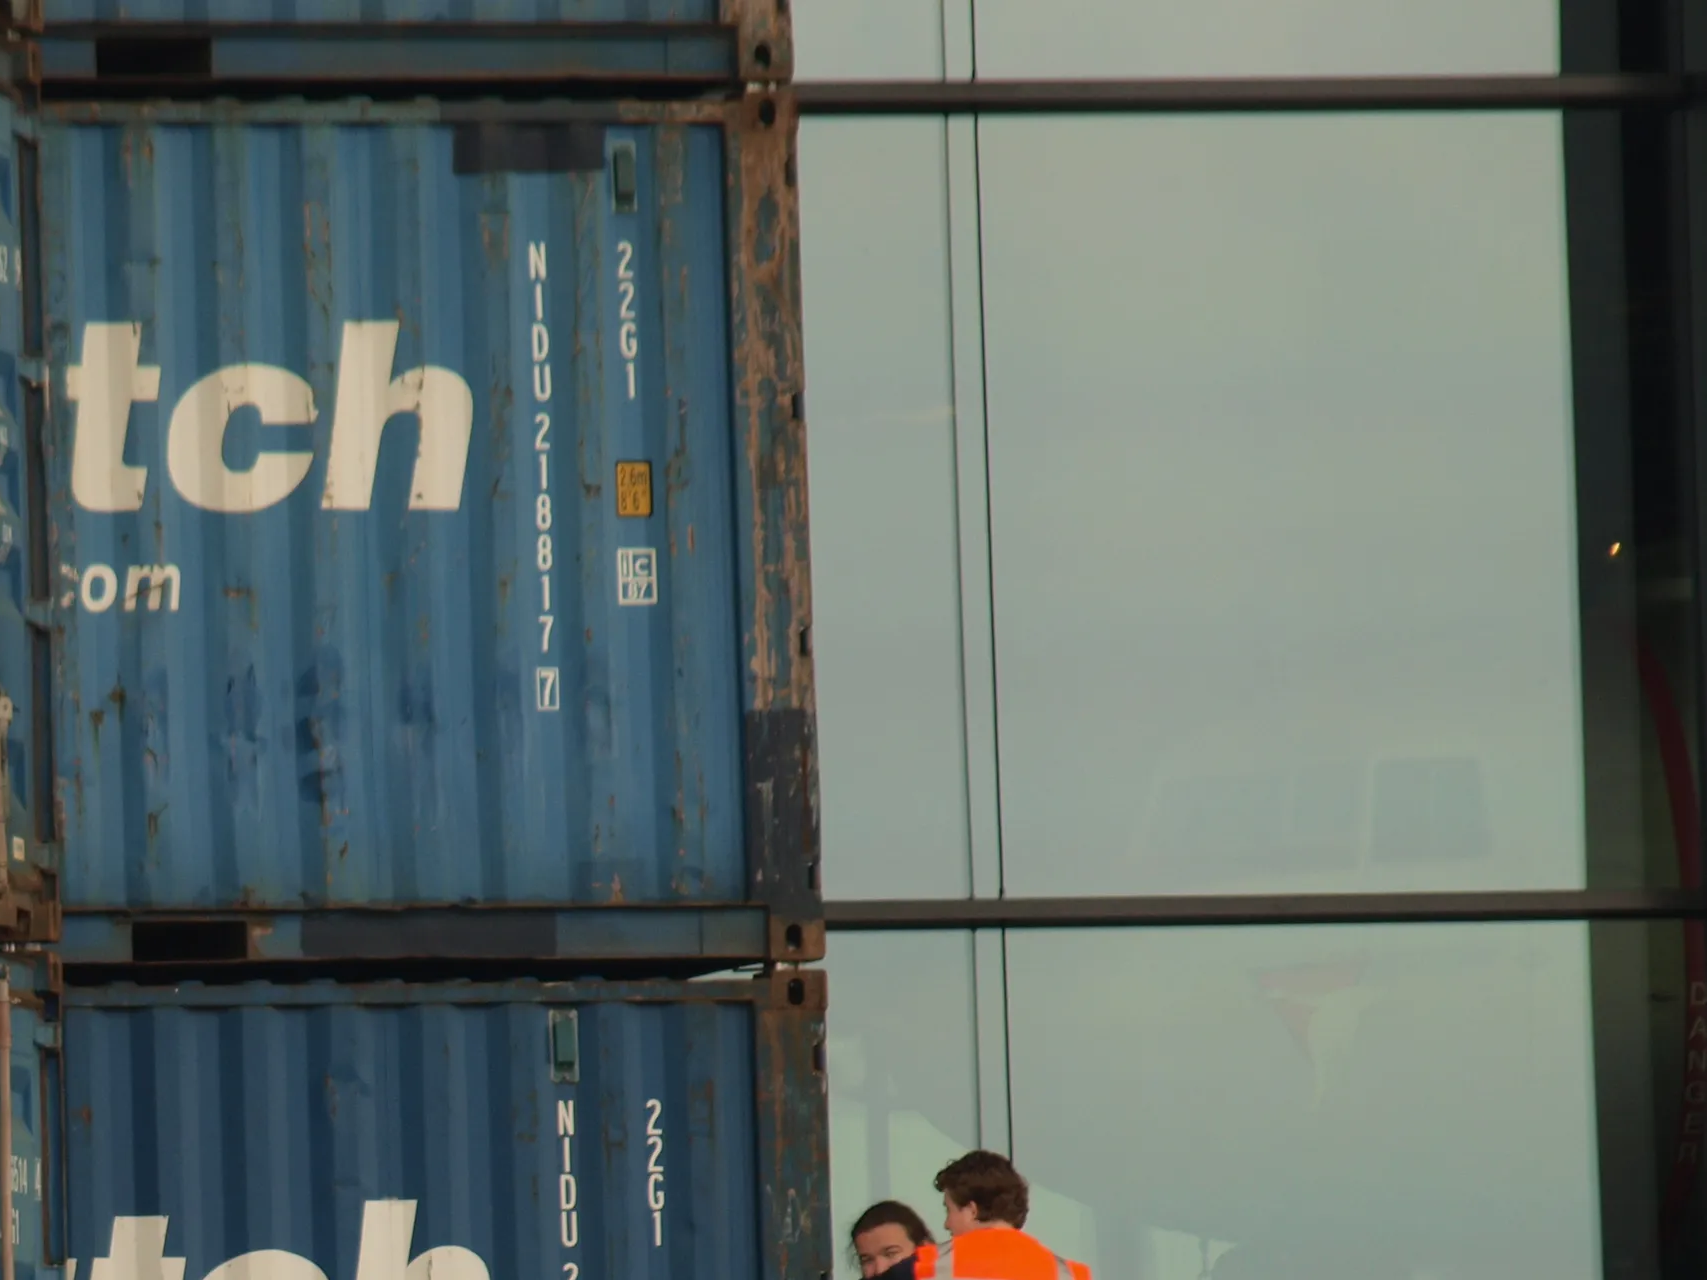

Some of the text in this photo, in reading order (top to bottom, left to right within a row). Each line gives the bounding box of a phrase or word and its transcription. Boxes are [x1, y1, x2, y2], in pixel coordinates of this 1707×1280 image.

[617, 242, 638, 400] 22G1
[66, 320, 474, 513] tch
[529, 241, 557, 708] NIDU 218817 7
[557, 1099, 579, 1248] NIDU
[645, 1097, 666, 1247] 22G1
